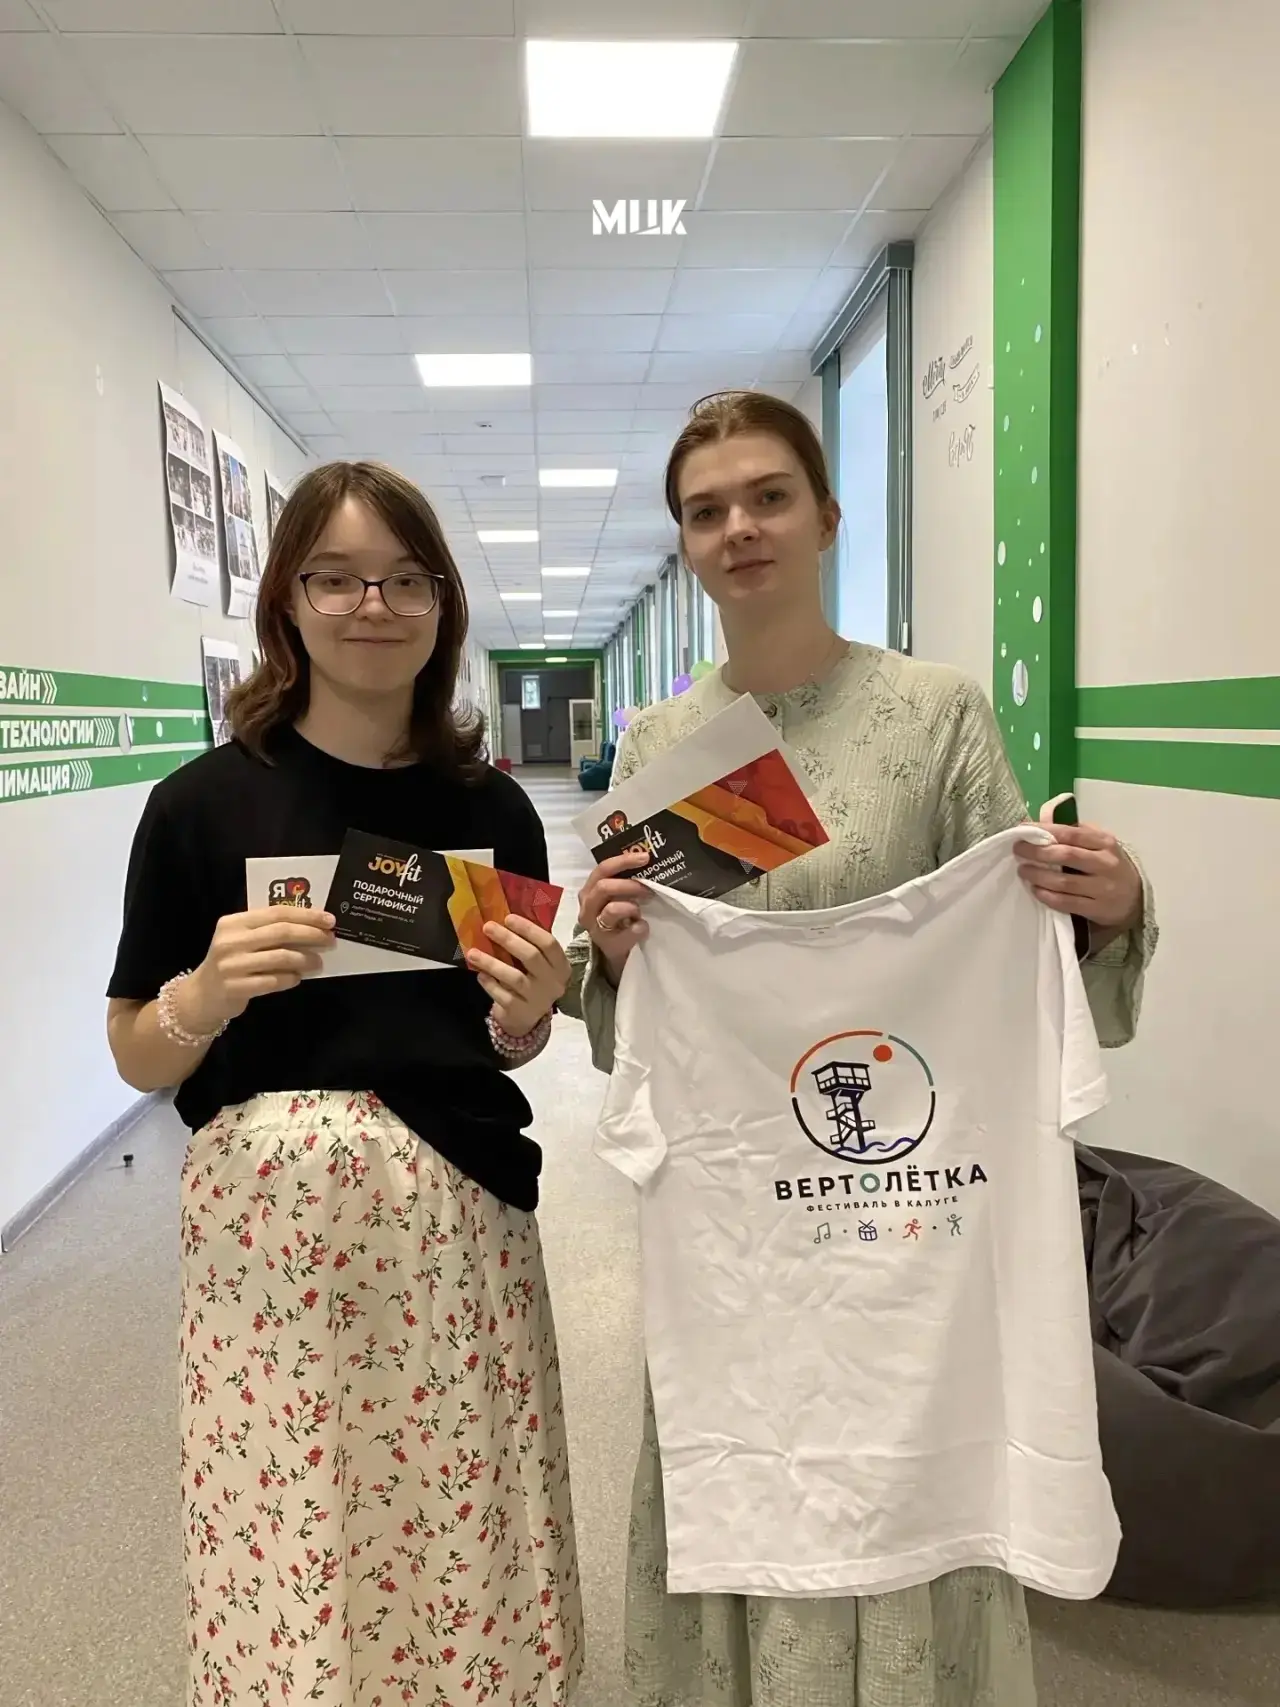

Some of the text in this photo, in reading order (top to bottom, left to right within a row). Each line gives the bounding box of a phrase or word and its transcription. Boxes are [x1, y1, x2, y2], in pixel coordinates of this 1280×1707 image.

[1, 720, 95, 748] ТЕХНОЛОГИИ
[600, 823, 613, 840] Я
[273, 882, 286, 898] Я
[353, 879, 424, 904] ПОДАРОЧНЫЙ
[353, 891, 419, 914] СЕРТИФИКАТ
[774, 1164, 988, 1200] ВЕРТОЛЁТКА
[806, 1195, 959, 1212] ФЕСТИВАЛЬ В КАЛУГЕ
